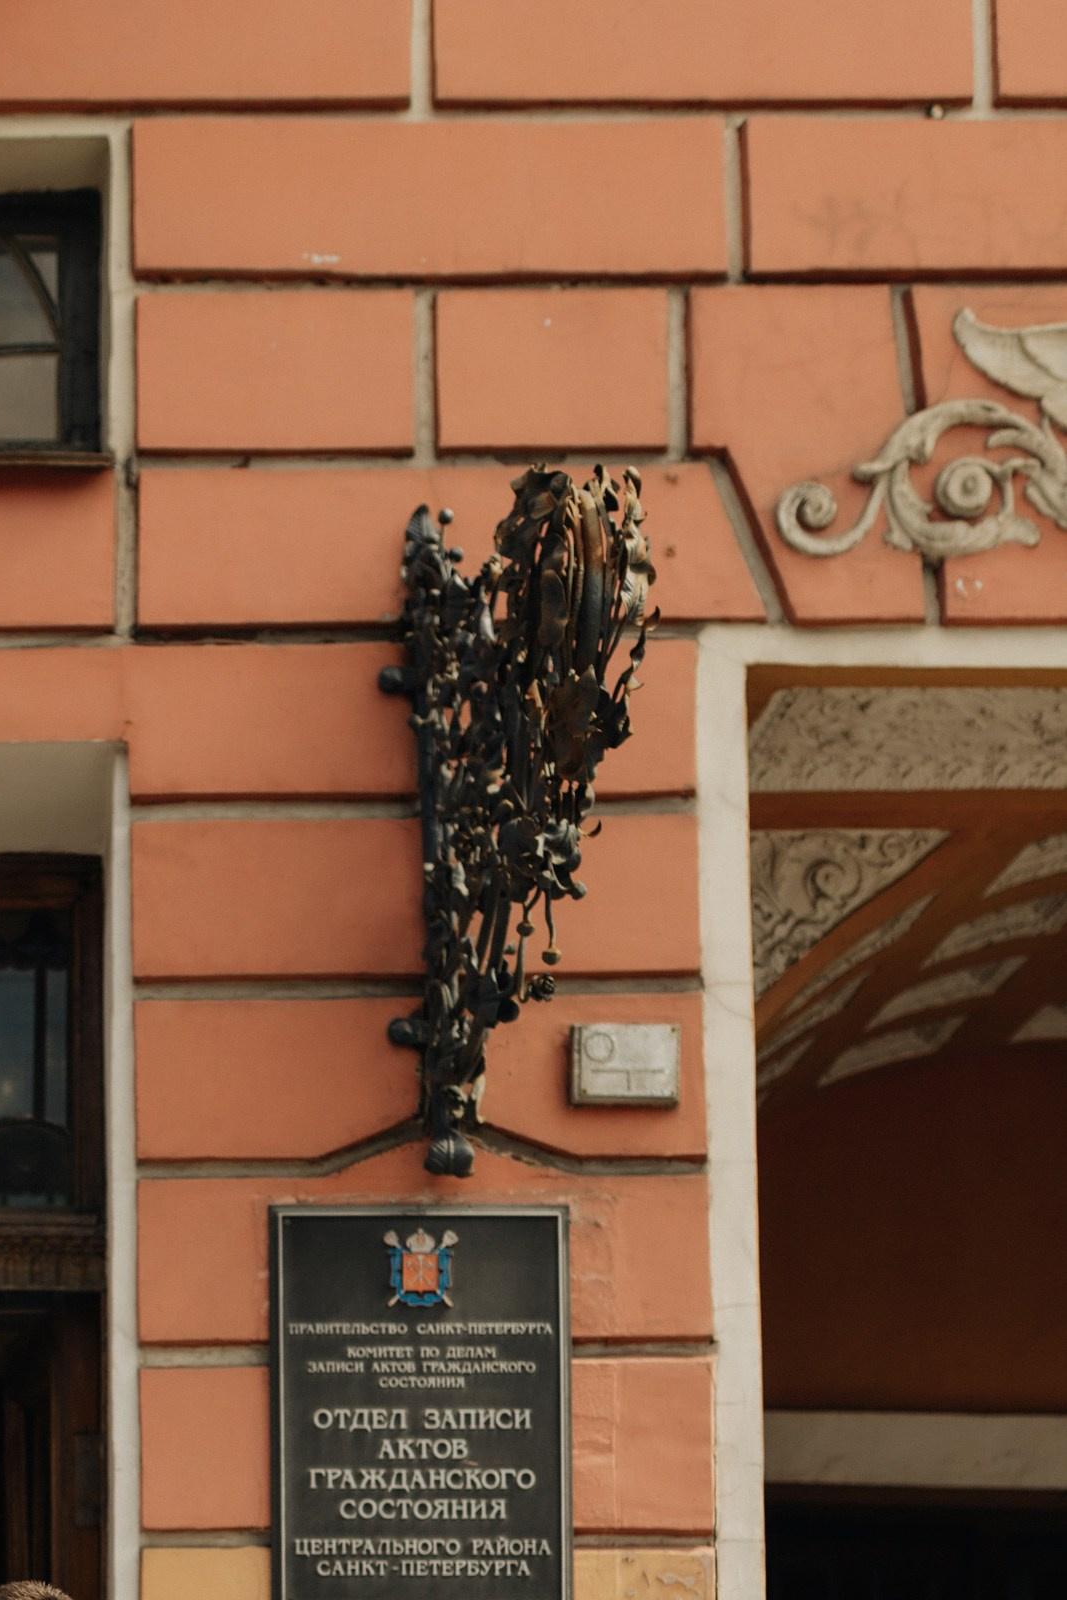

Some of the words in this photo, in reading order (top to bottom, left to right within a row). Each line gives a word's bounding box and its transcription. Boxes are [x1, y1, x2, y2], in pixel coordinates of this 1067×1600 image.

[288, 1322, 409, 1336] ПРАВИТЕЛЬСТВО
[416, 1322, 554, 1336] САНКТ-ПЕТЕРБУРГА
[346, 1346, 414, 1359] КОМИТЕТ
[420, 1346, 439, 1359] ПО
[445, 1346, 497, 1360] ДЕЛАМ
[307, 1360, 365, 1373] ЗАПИСИ
[371, 1360, 416, 1373] АКТОВ
[422, 1360, 537, 1375] ГРАЖДАНСКОГО
[378, 1376, 466, 1389] СОСТОЯНИЯ
[312, 1408, 408, 1433] ОТДЕЛ
[424, 1408, 533, 1430] ЗАПИСИ
[377, 1438, 469, 1460] АКТОВ
[308, 1468, 537, 1493] ГРАЖДАНСКОГО
[339, 1499, 507, 1520] СОСТОЯНИЯ
[293, 1538, 462, 1558] ЦЕНТРАЛЬНОГО
[471, 1535, 552, 1557] РАЙОНА
